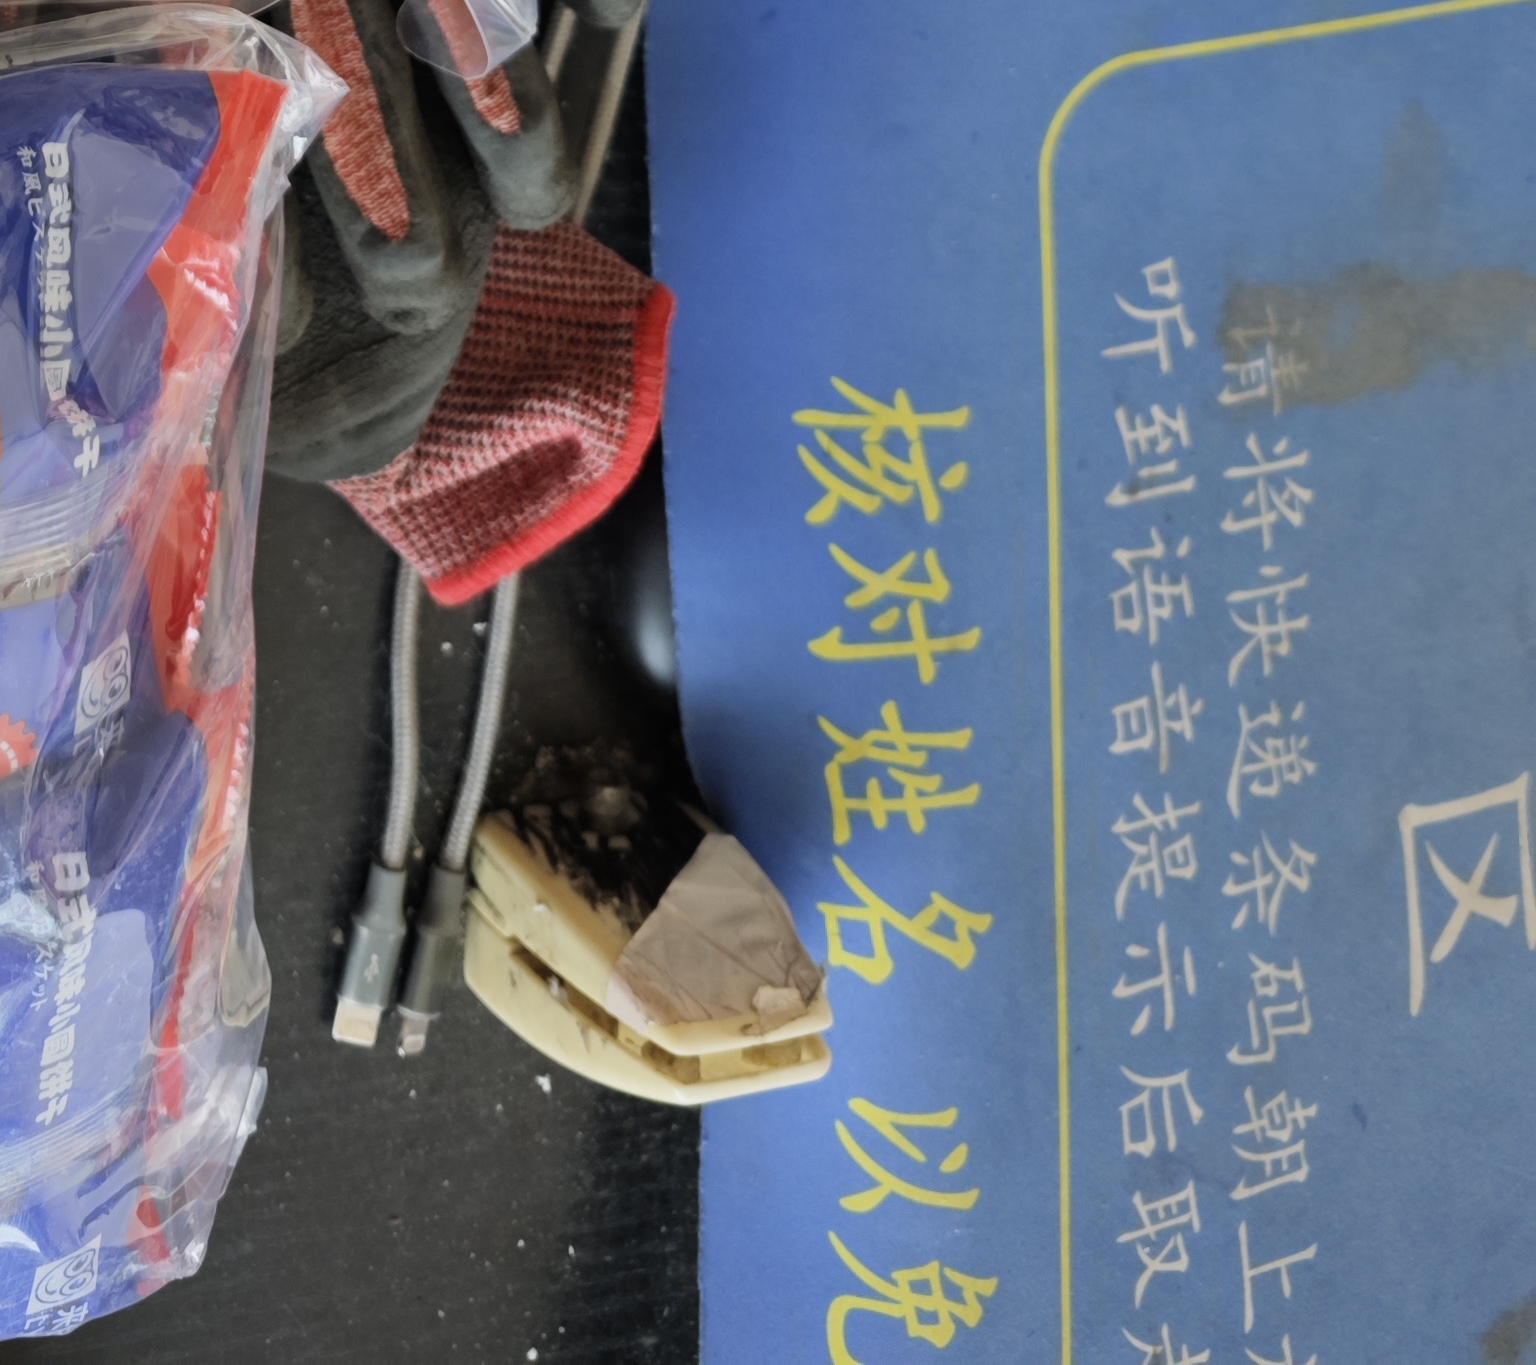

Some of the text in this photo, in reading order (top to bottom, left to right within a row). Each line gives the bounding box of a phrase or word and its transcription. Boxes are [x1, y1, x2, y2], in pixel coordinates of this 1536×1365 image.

[788, 375, 996, 988] 核对姓名
[1397, 775, 1536, 1018] 区
